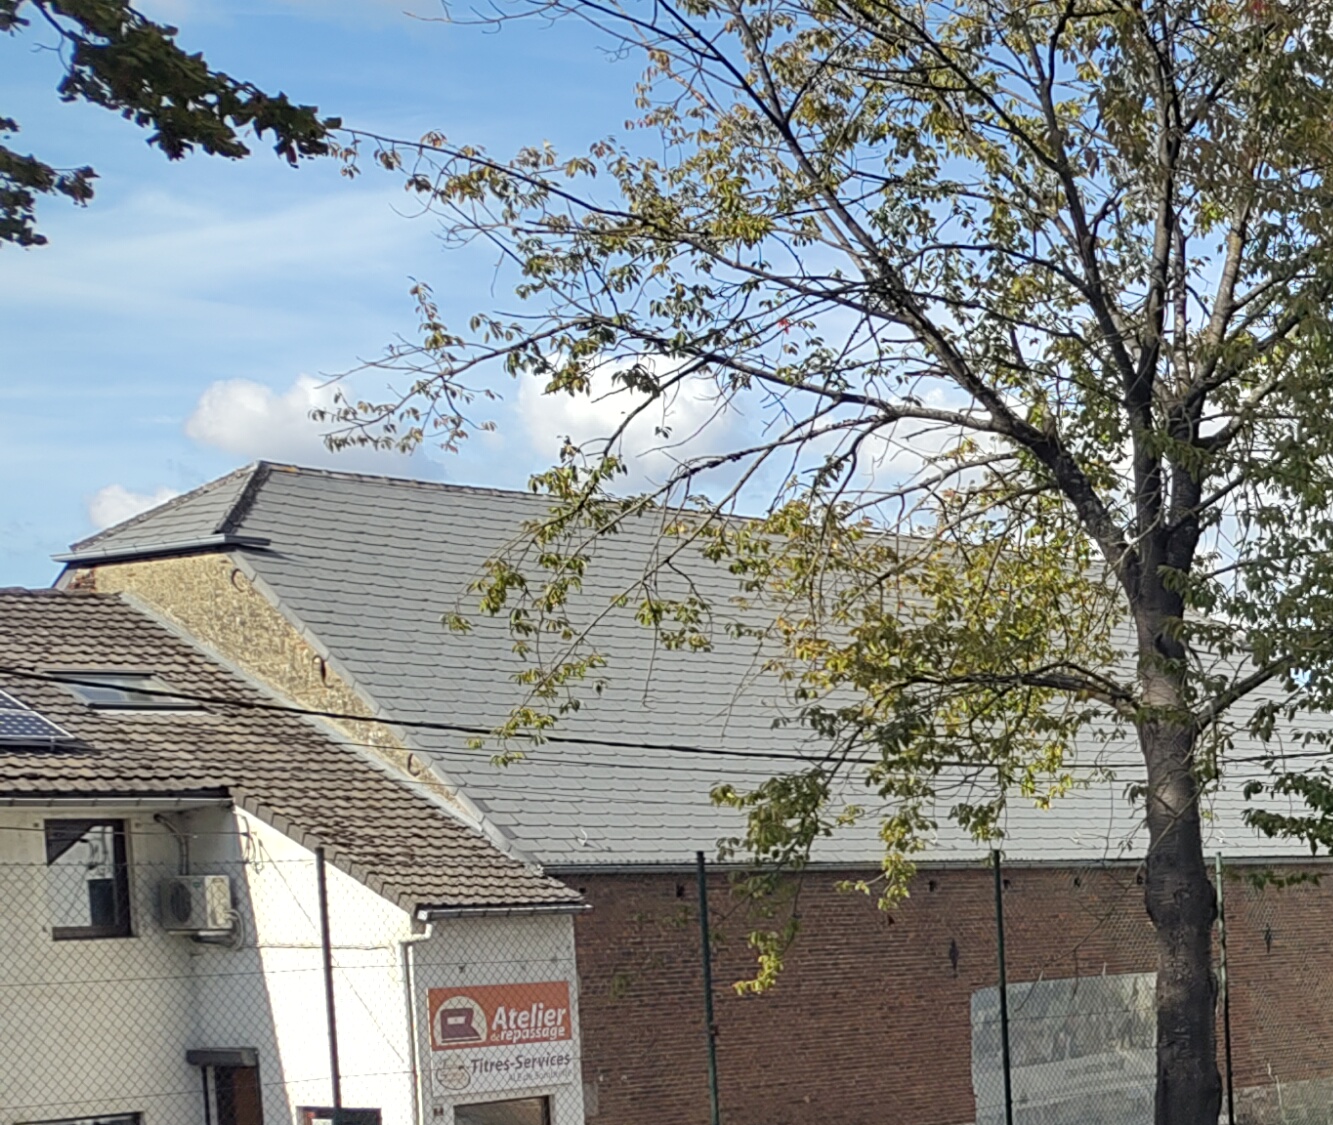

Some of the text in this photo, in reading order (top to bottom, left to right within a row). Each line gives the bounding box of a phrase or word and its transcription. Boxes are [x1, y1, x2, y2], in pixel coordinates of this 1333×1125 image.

[491, 1002, 567, 1031] Atelier
[500, 1026, 566, 1044] repassage
[470, 1052, 571, 1075] Titres-Services
